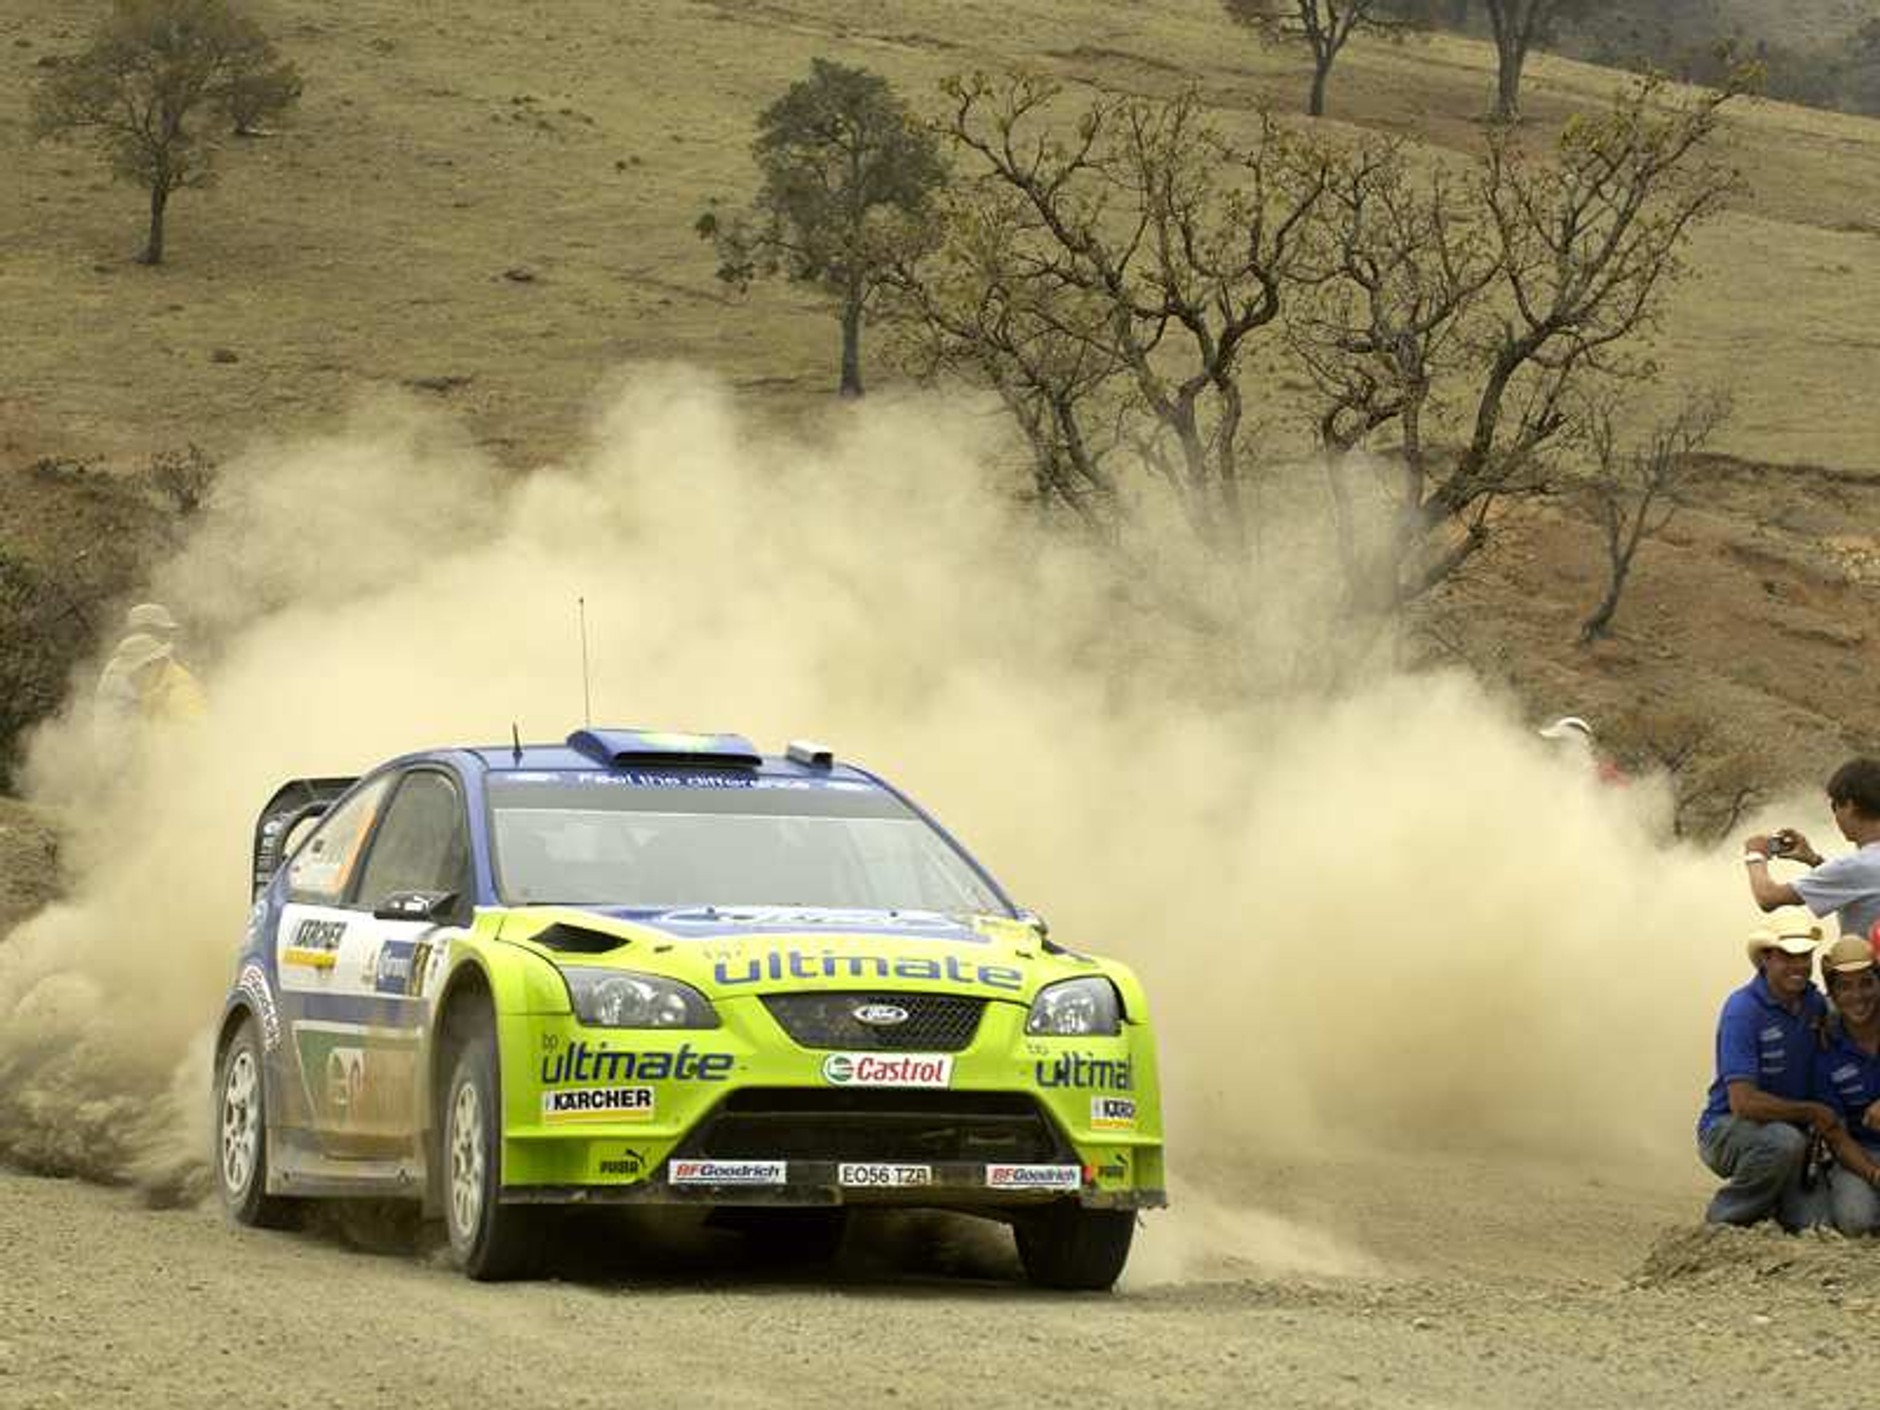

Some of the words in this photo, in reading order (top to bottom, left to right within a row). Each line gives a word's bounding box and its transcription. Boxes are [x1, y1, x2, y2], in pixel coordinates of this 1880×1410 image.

[714, 951, 1023, 991] ultimate
[541, 1041, 735, 1084] ultimate
[856, 1056, 945, 1082] Castrol
[676, 1163, 779, 1178] BFGoodrich
[843, 1166, 890, 1183] EO56
[993, 1167, 1076, 1182] BFGoodrich
